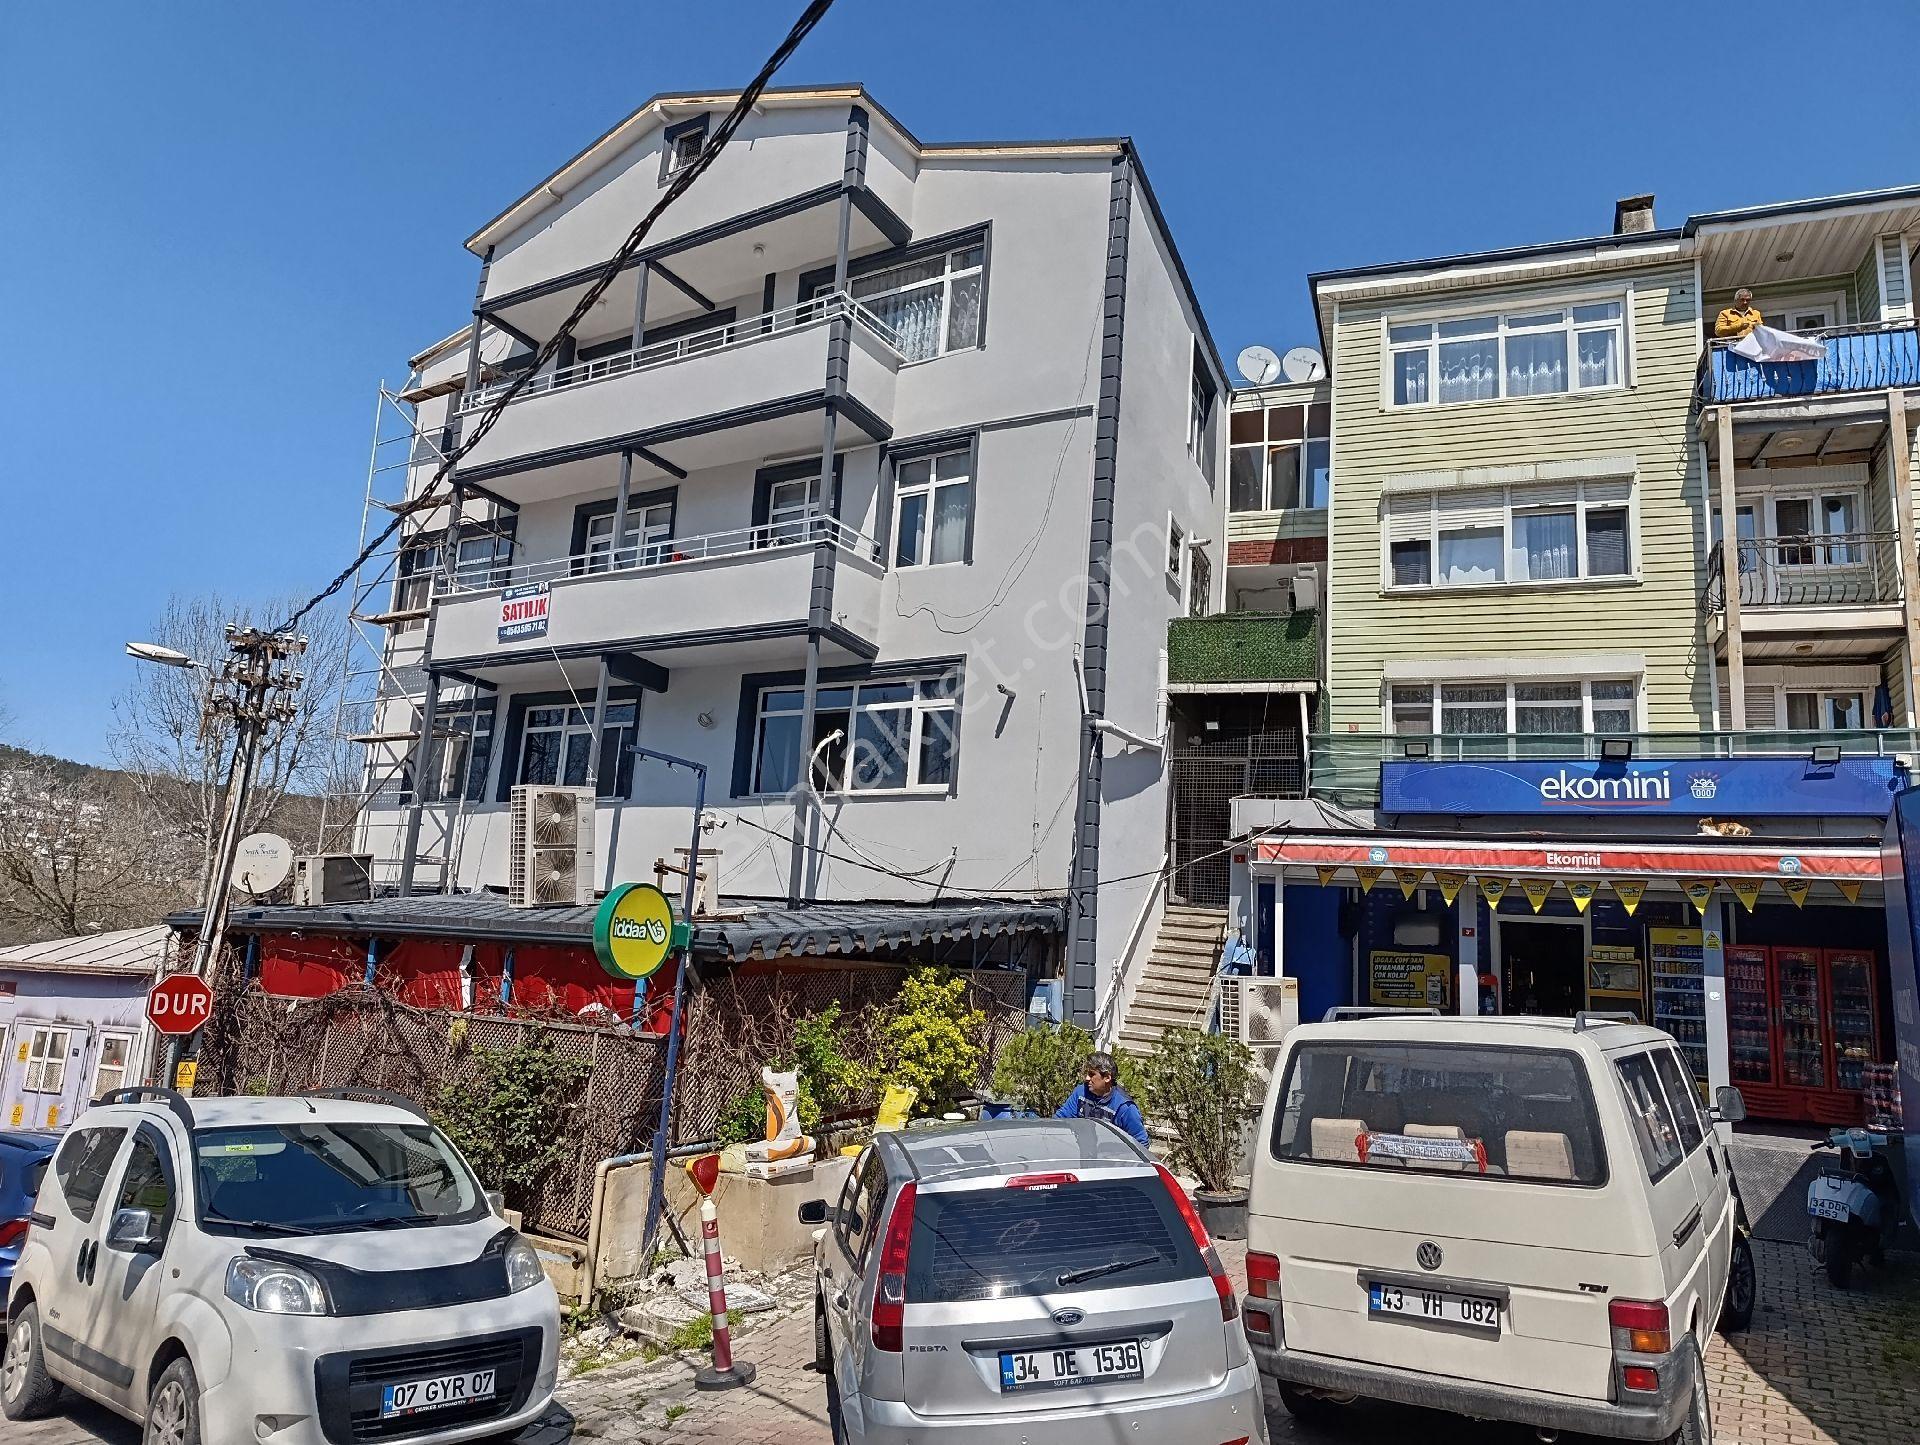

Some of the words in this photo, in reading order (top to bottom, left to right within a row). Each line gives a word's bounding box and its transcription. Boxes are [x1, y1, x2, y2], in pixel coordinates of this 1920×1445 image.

[502, 597, 547, 622] SATILIK
[1540, 769, 1670, 799] ekomini
[1546, 852, 1601, 866] Ekomini
[613, 918, 647, 938] iddaa
[153, 993, 206, 1015] DUR
[1812, 1199, 1825, 1208] 34
[1818, 1209, 1838, 1219] 953
[1578, 1282, 1609, 1294] TDI
[1382, 1288, 1404, 1311] 43
[1421, 1293, 1443, 1317] VH
[1461, 1299, 1496, 1325] 082
[1060, 1312, 1081, 1324] Ford
[909, 1345, 949, 1353] FIESTA
[1014, 1355, 1040, 1381] 34
[1053, 1350, 1079, 1377] DE
[1093, 1345, 1138, 1373] 1536
[1003, 1371, 1014, 1379] TR
[1053, 1379, 1068, 1387] SOFT
[1070, 1376, 1095, 1386] GARAGE
[393, 1384, 418, 1408] 07
[425, 1376, 465, 1402] GYR
[472, 1371, 494, 1394] 07
